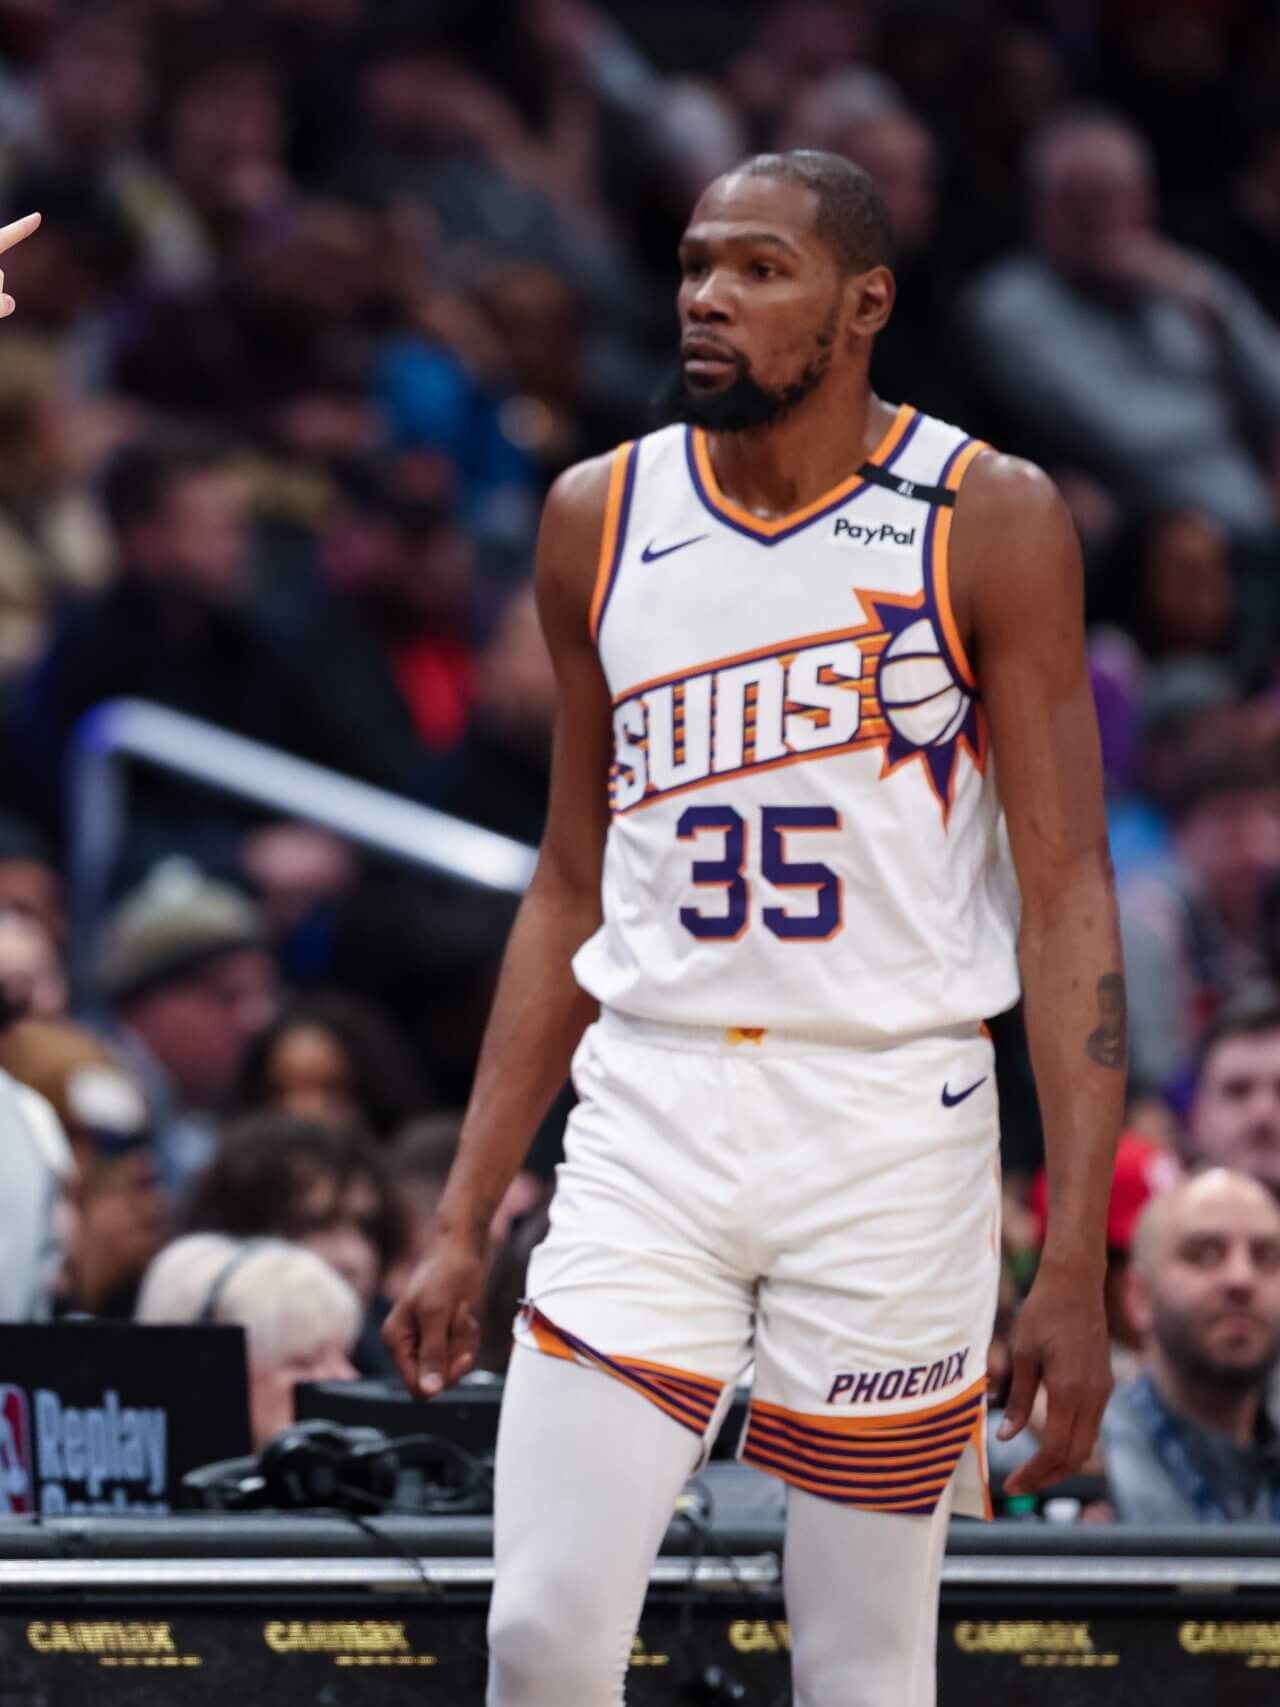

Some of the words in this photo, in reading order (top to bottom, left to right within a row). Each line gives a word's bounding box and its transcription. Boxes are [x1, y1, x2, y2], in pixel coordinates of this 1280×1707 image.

[833, 518, 916, 546] PayPal
[612, 641, 862, 813] SUNS
[676, 805, 844, 942] 35
[826, 1345, 970, 1404] PHOENIX
[34, 1389, 167, 1496] Replay
